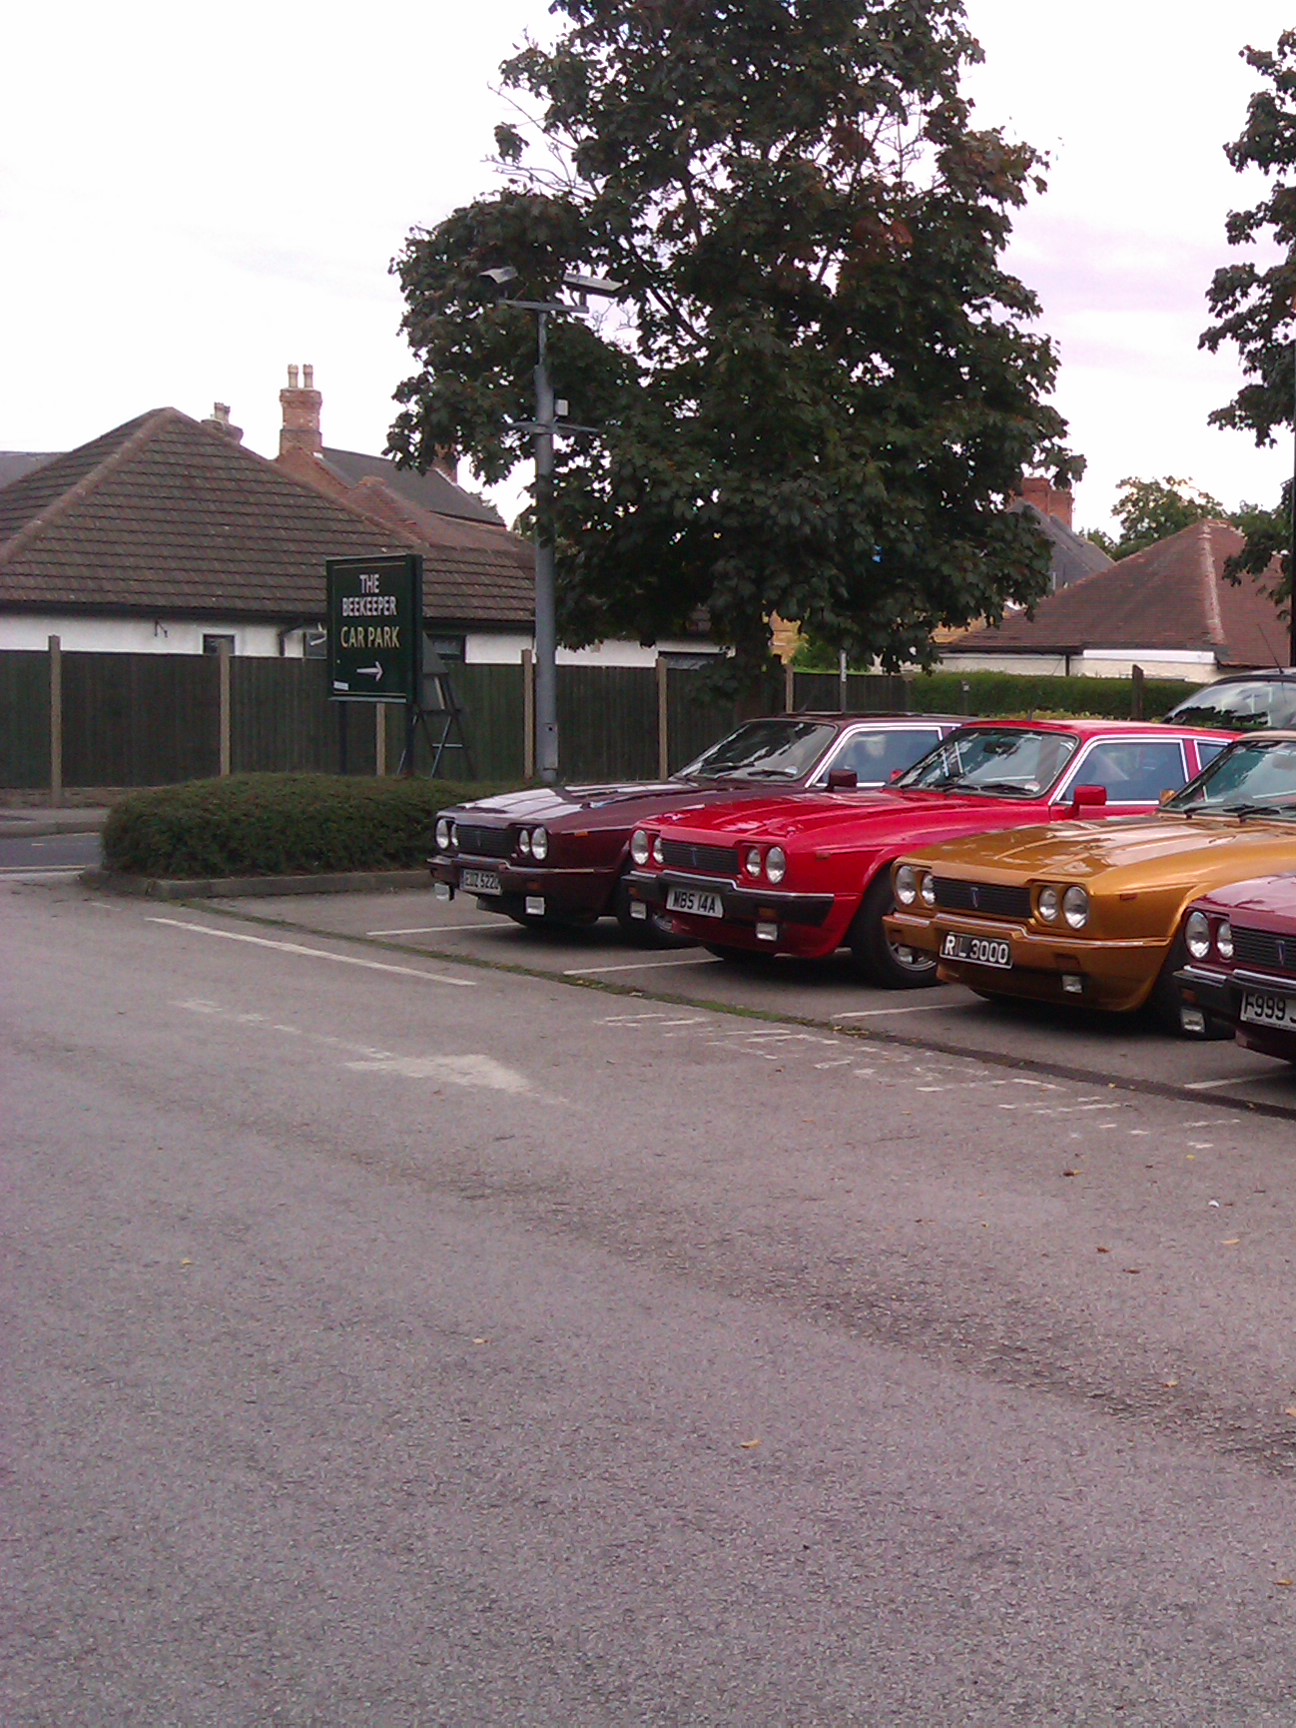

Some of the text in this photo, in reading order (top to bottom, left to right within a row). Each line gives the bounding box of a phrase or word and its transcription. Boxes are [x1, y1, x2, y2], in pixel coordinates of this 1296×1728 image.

[359, 573, 380, 594] THE
[342, 596, 397, 617] BEEKEEPER
[340, 626, 400, 648] CAR PARK
[969, 939, 1009, 964] 3000
[1243, 992, 1286, 1021] F999
